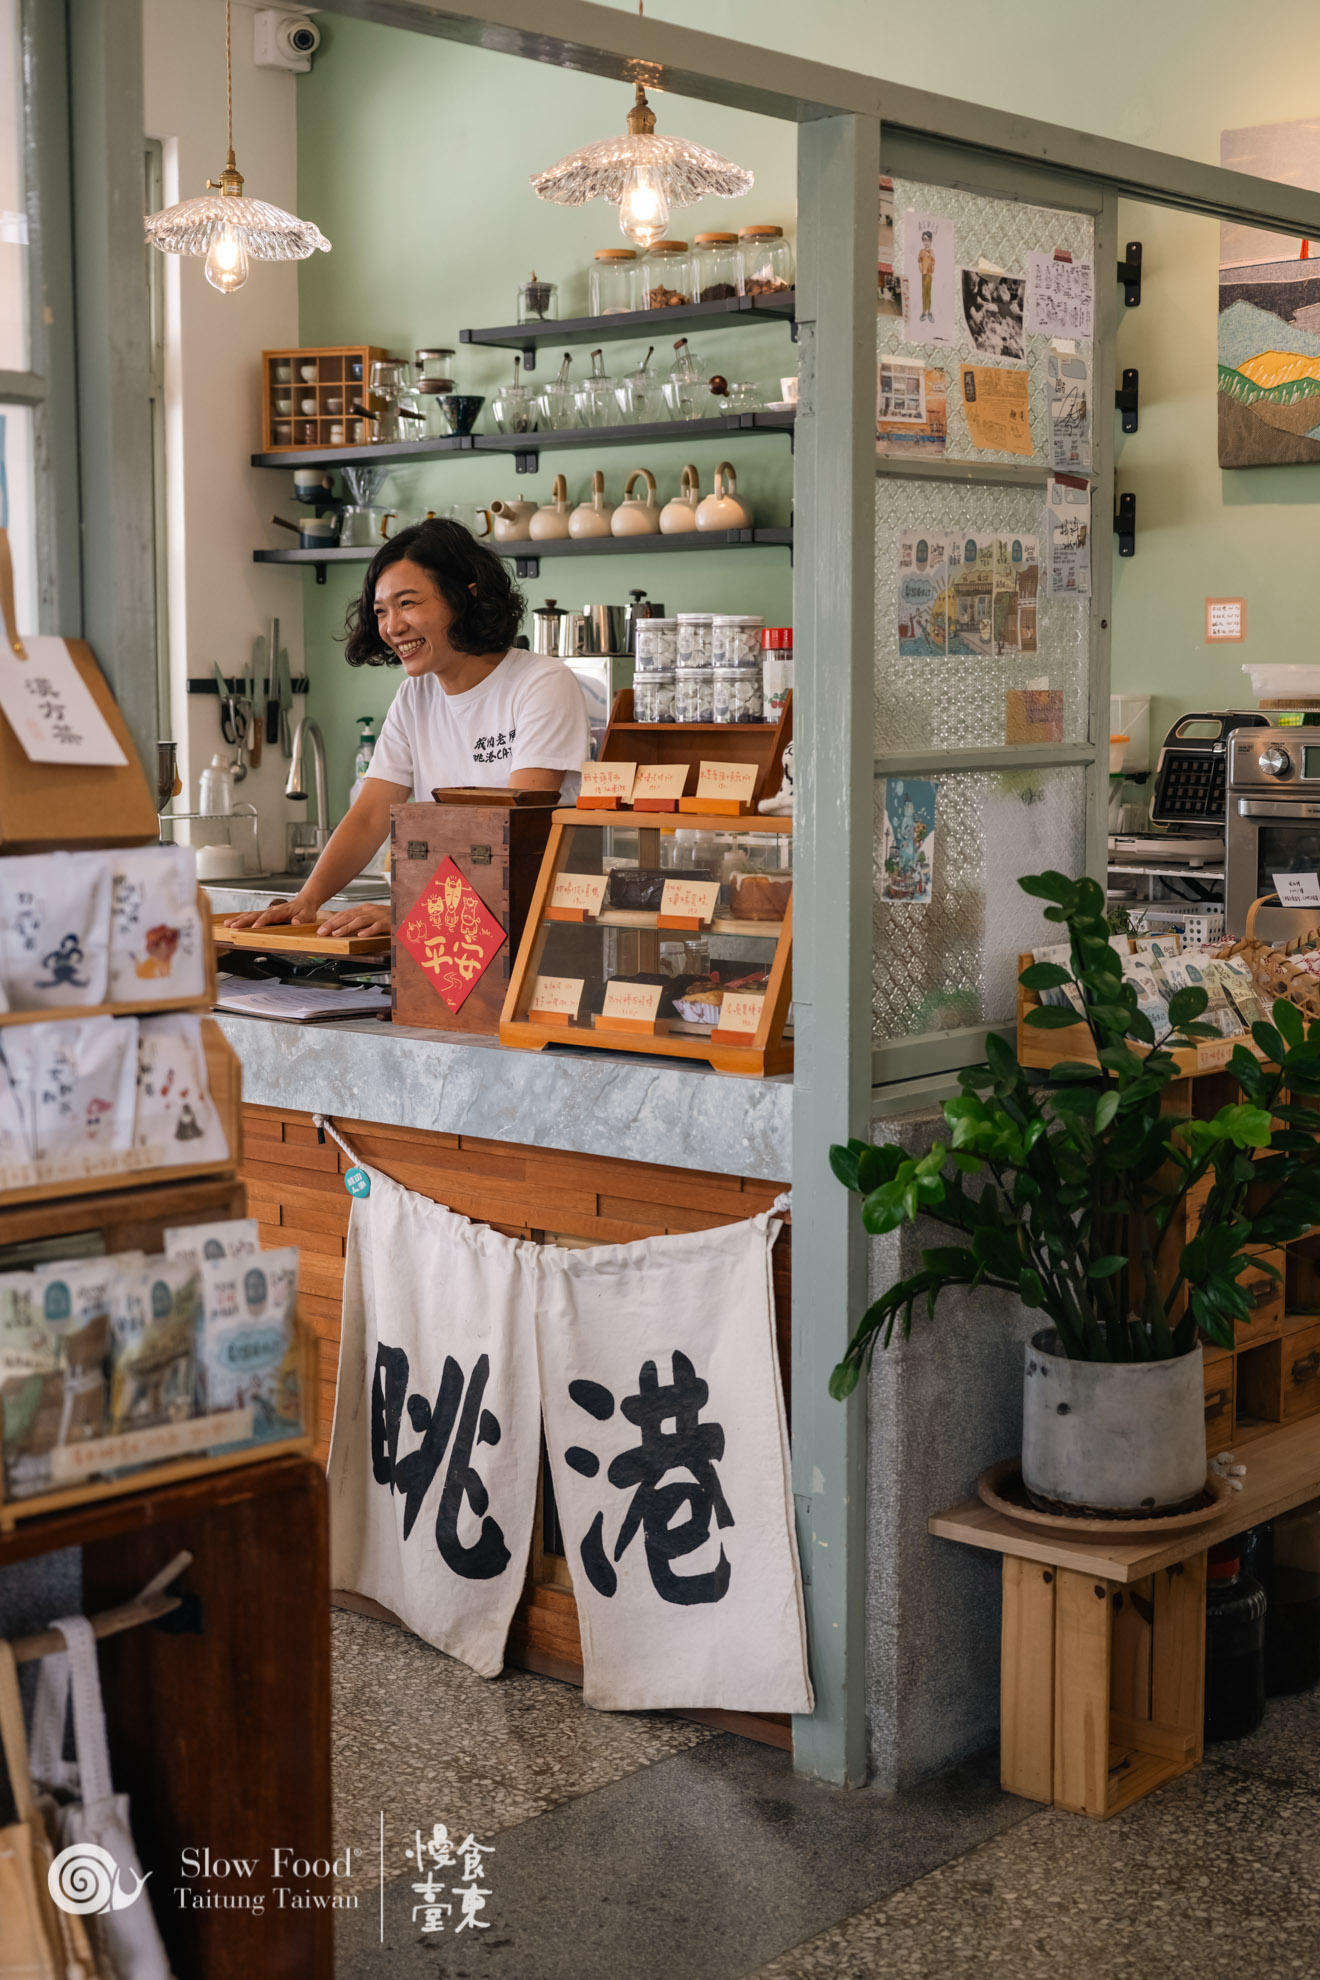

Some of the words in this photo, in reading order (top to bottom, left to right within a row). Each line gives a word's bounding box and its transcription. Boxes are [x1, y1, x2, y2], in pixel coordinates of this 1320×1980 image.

[24, 677, 84, 746] 漢方茶
[421, 935, 484, 981] 平安
[371, 1341, 735, 1606] 眺港
